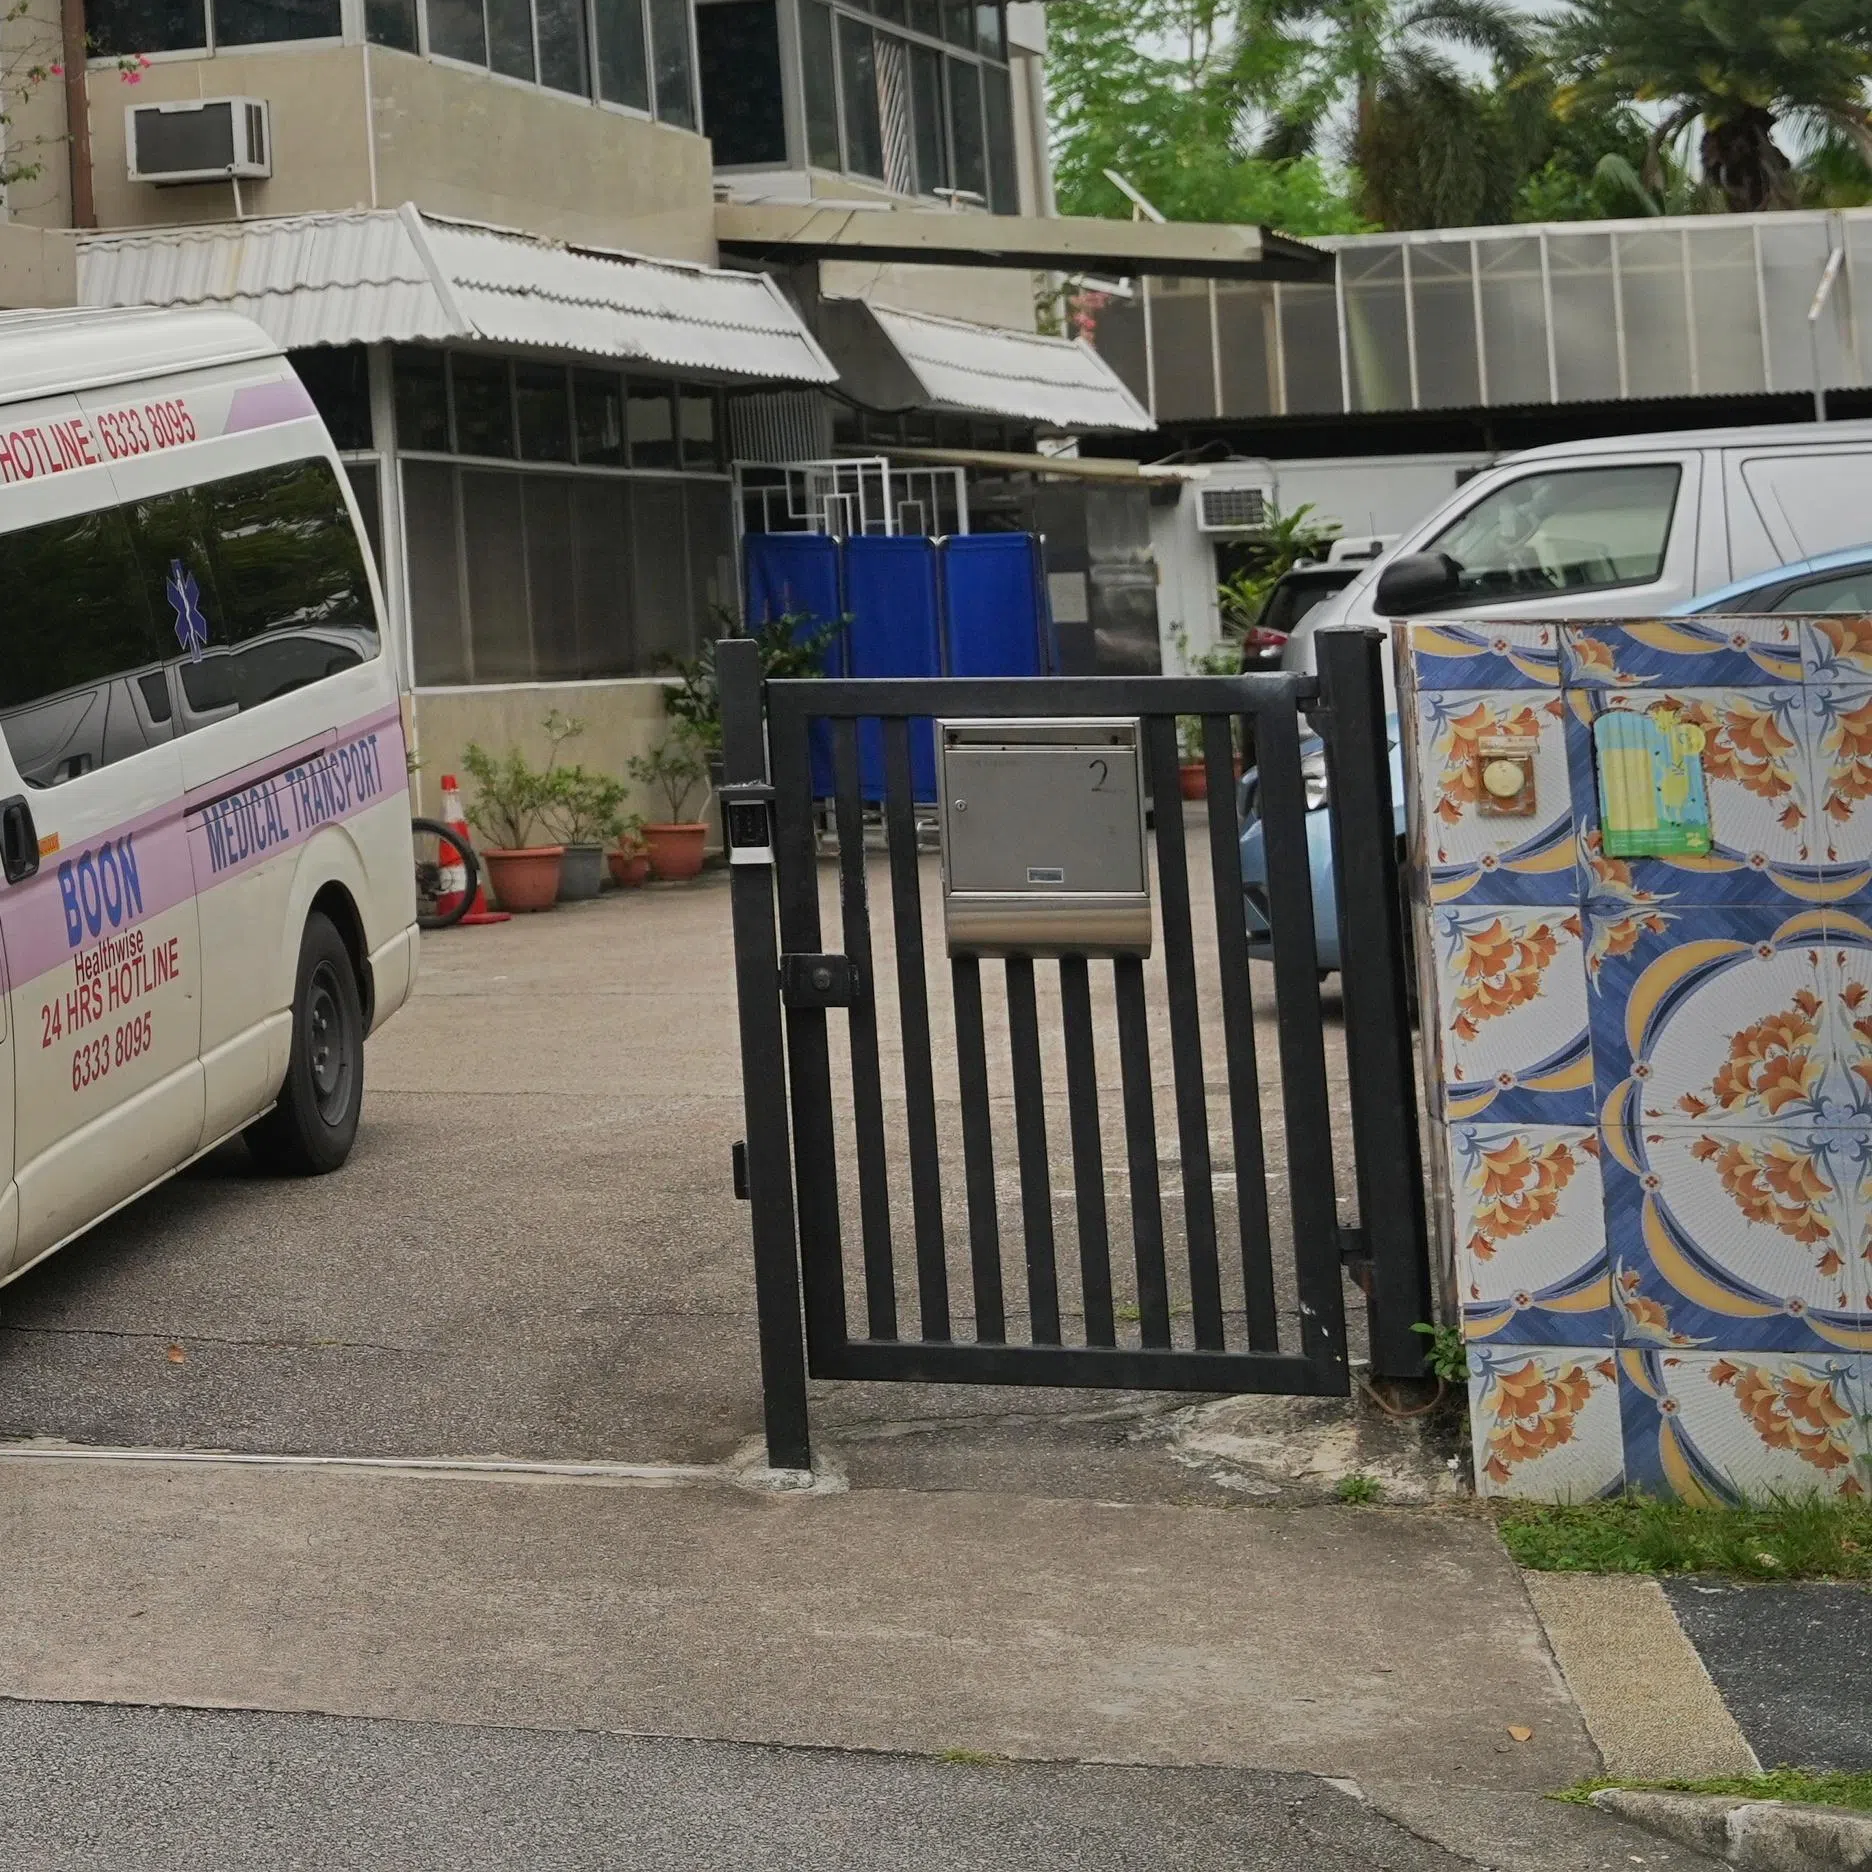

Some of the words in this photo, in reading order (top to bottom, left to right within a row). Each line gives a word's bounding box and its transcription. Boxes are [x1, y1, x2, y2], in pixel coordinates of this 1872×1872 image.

[97, 408, 150, 460] 6333
[145, 398, 196, 449] 8095
[201, 779, 290, 874] MEDICAL
[285, 733, 383, 833] TRANSPORT
[1089, 759, 1114, 794] 2
[57, 831, 143, 949] BOON
[41, 998, 62, 1049] 24
[66, 978, 103, 1034] HRS
[108, 937, 179, 1012] HOTLINE
[74, 927, 144, 986] Healthwise
[72, 1034, 110, 1092] 6333
[115, 1010, 152, 1068] 8095
